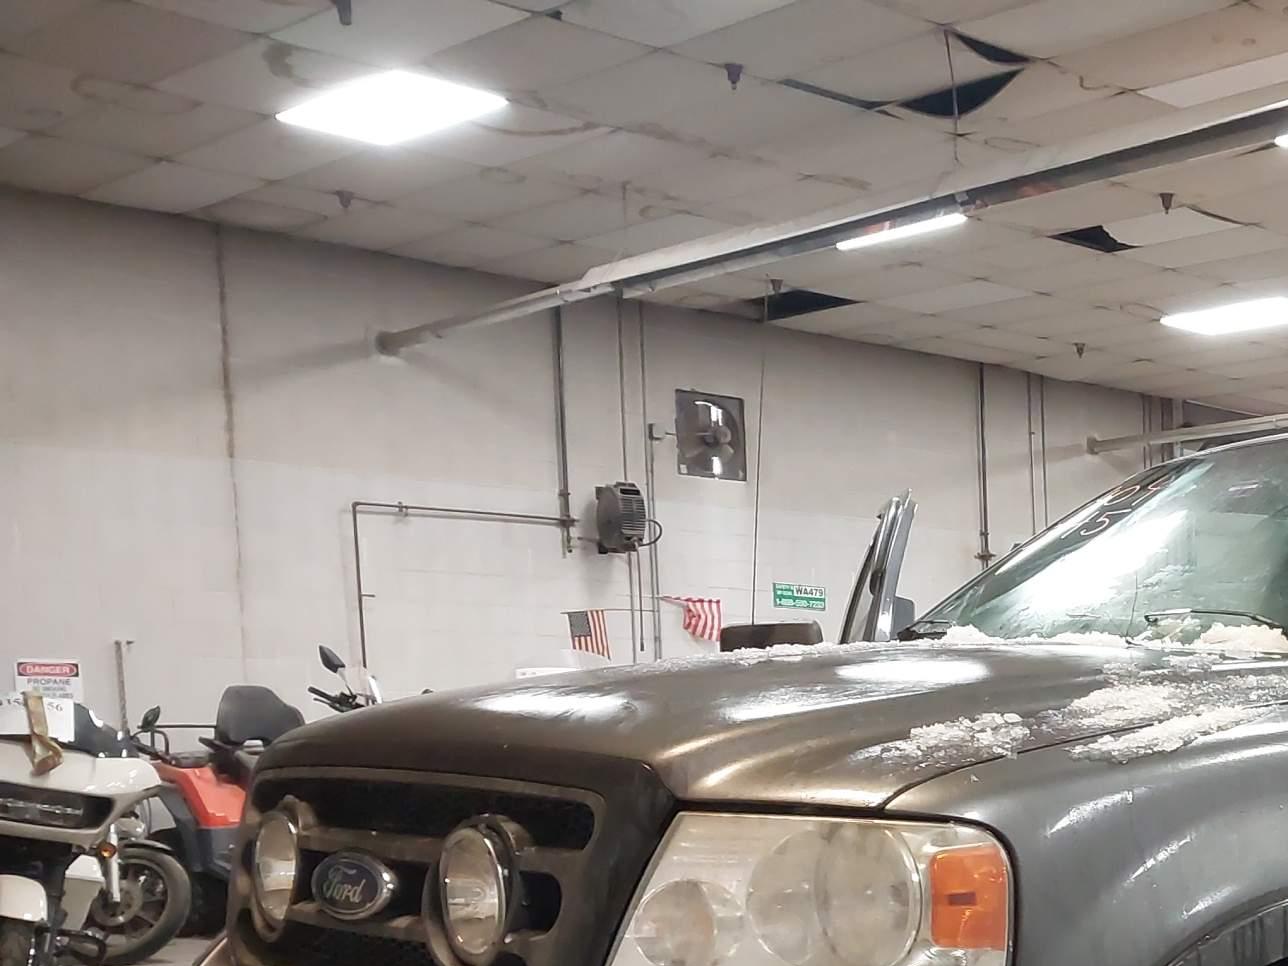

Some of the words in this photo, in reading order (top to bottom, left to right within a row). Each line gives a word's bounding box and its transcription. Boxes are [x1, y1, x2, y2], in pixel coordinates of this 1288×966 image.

[795, 586, 824, 597] WA479
[26, 665, 70, 674] DANGER
[322, 864, 367, 904] Ford
